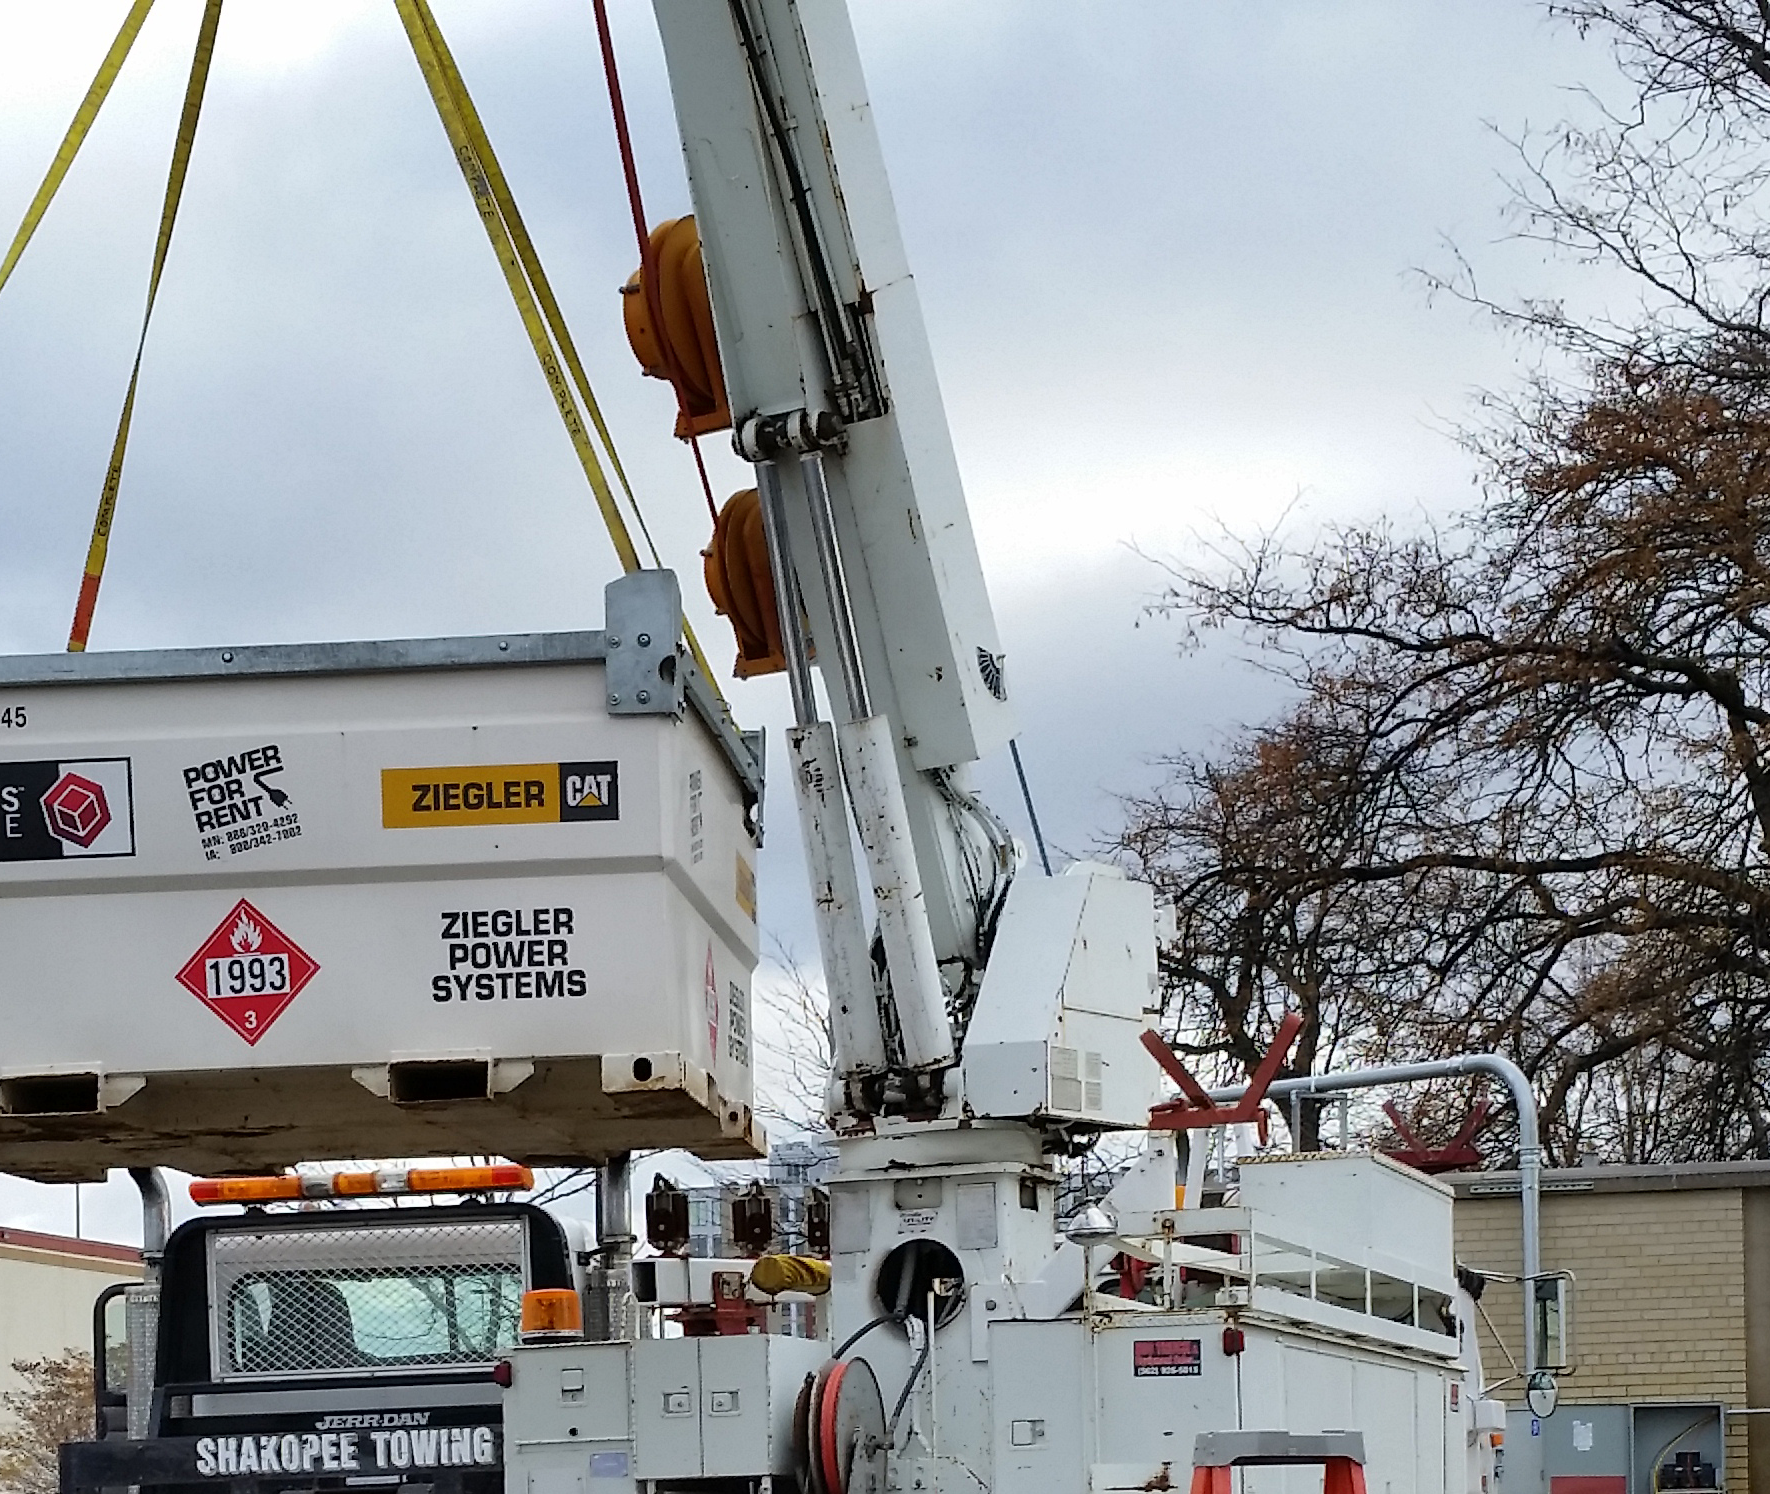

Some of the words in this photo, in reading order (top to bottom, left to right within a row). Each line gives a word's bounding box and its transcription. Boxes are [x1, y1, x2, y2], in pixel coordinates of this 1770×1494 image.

[183, 744, 283, 789] POWER
[189, 778, 245, 812] FOR
[411, 779, 545, 812] ZIEGLER
[565, 773, 612, 807] CAT
[195, 795, 264, 833] RENT
[440, 907, 575, 940] ZIEGLER
[448, 939, 569, 971] POWER
[209, 956, 287, 996] 1993
[431, 969, 588, 1002] SYSTEMS
[244, 1010, 258, 1029] 3
[195, 1430, 361, 1477] SHAKOPEE
[370, 1426, 497, 1470] TOWING
